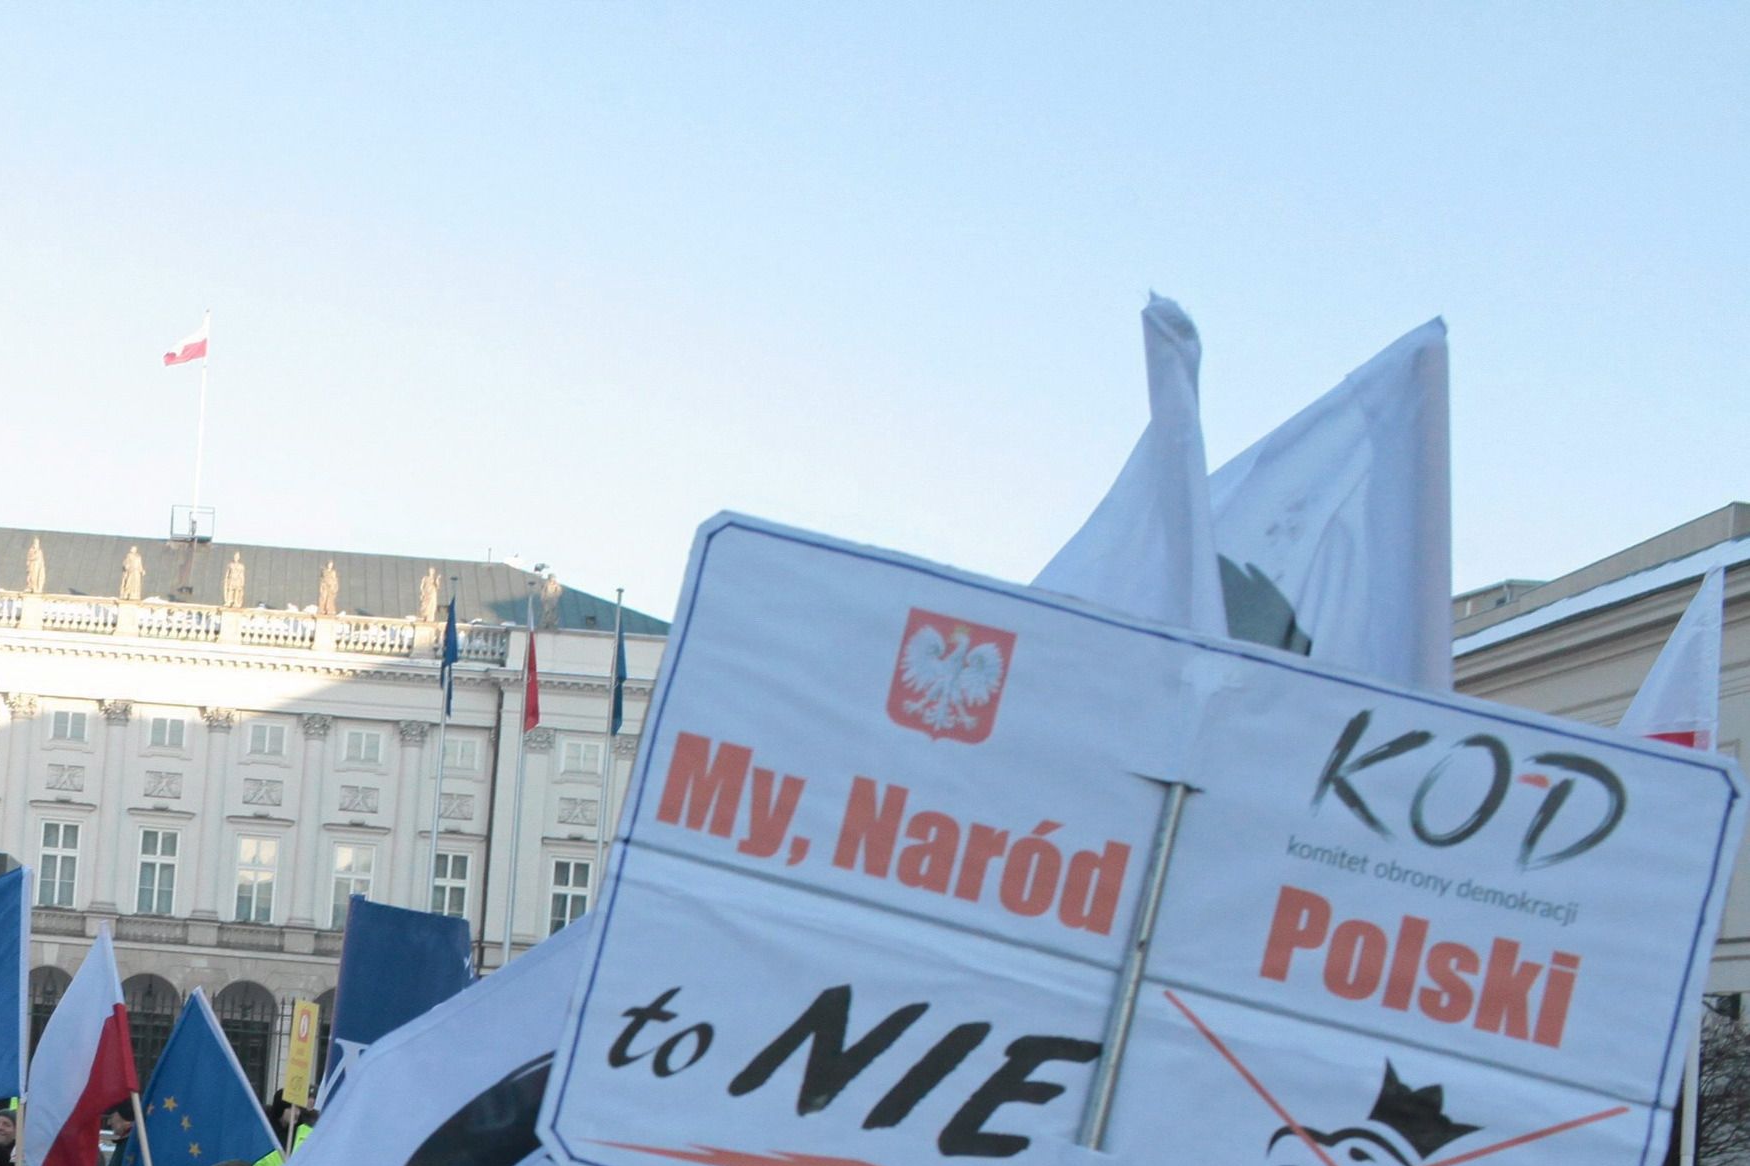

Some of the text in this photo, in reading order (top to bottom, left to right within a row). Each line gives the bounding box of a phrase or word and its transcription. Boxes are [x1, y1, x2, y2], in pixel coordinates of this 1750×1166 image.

[656, 731, 1132, 936] My, Naród
[1308, 708, 1627, 873] KOD
[1286, 835, 1579, 926] komitet obrony demokracji
[1259, 884, 1581, 1049] Polski
[608, 983, 1105, 1158] to NIE
